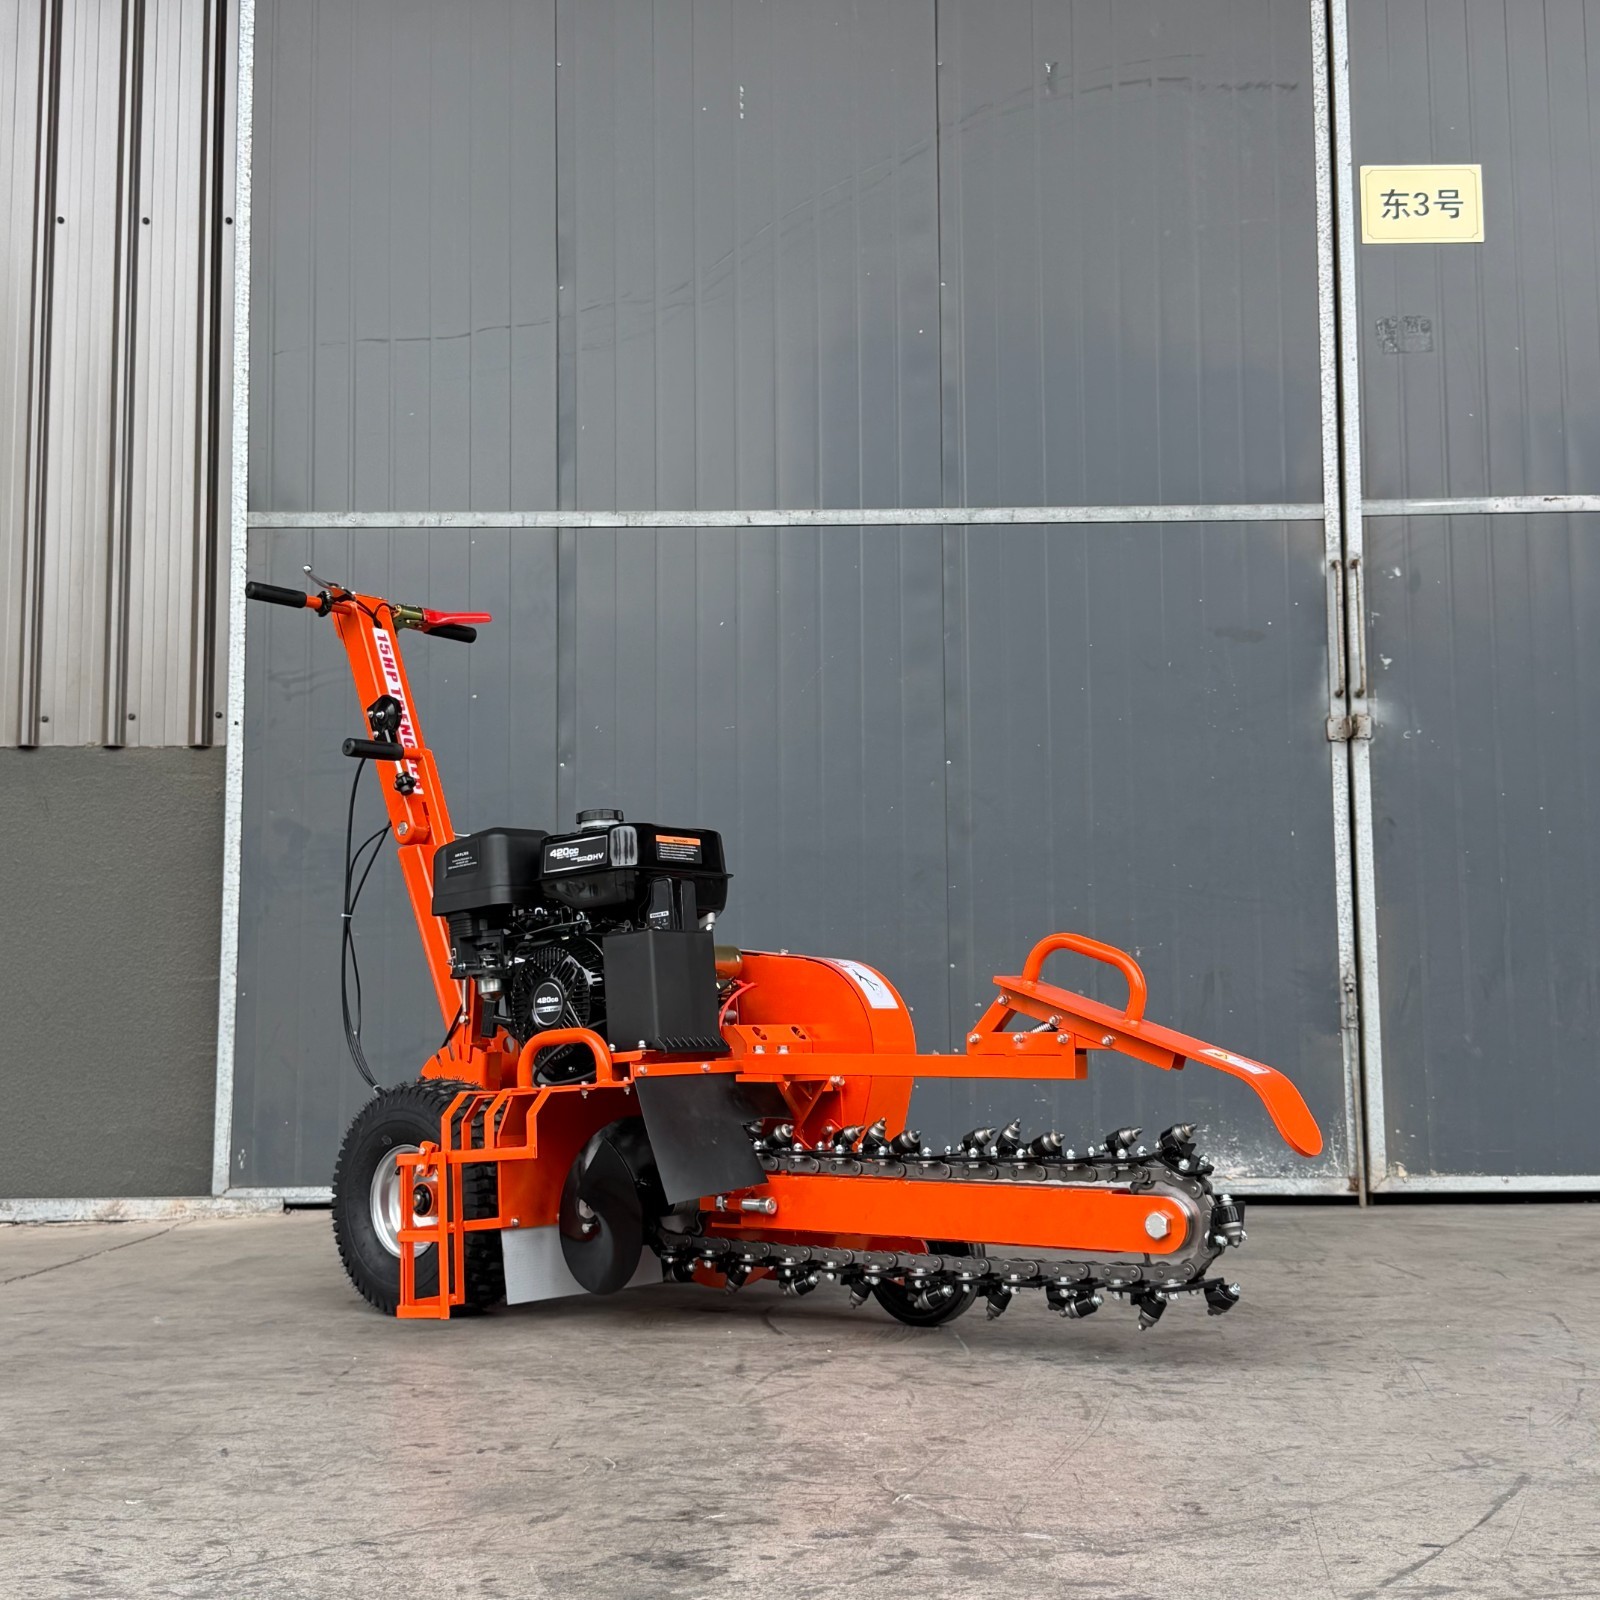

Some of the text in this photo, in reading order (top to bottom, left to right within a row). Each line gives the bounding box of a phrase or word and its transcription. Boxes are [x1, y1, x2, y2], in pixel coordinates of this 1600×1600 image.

[1380, 188, 1464, 220] 东3号
[377, 633, 398, 683] 15HP
[549, 847, 580, 858] 420cc
